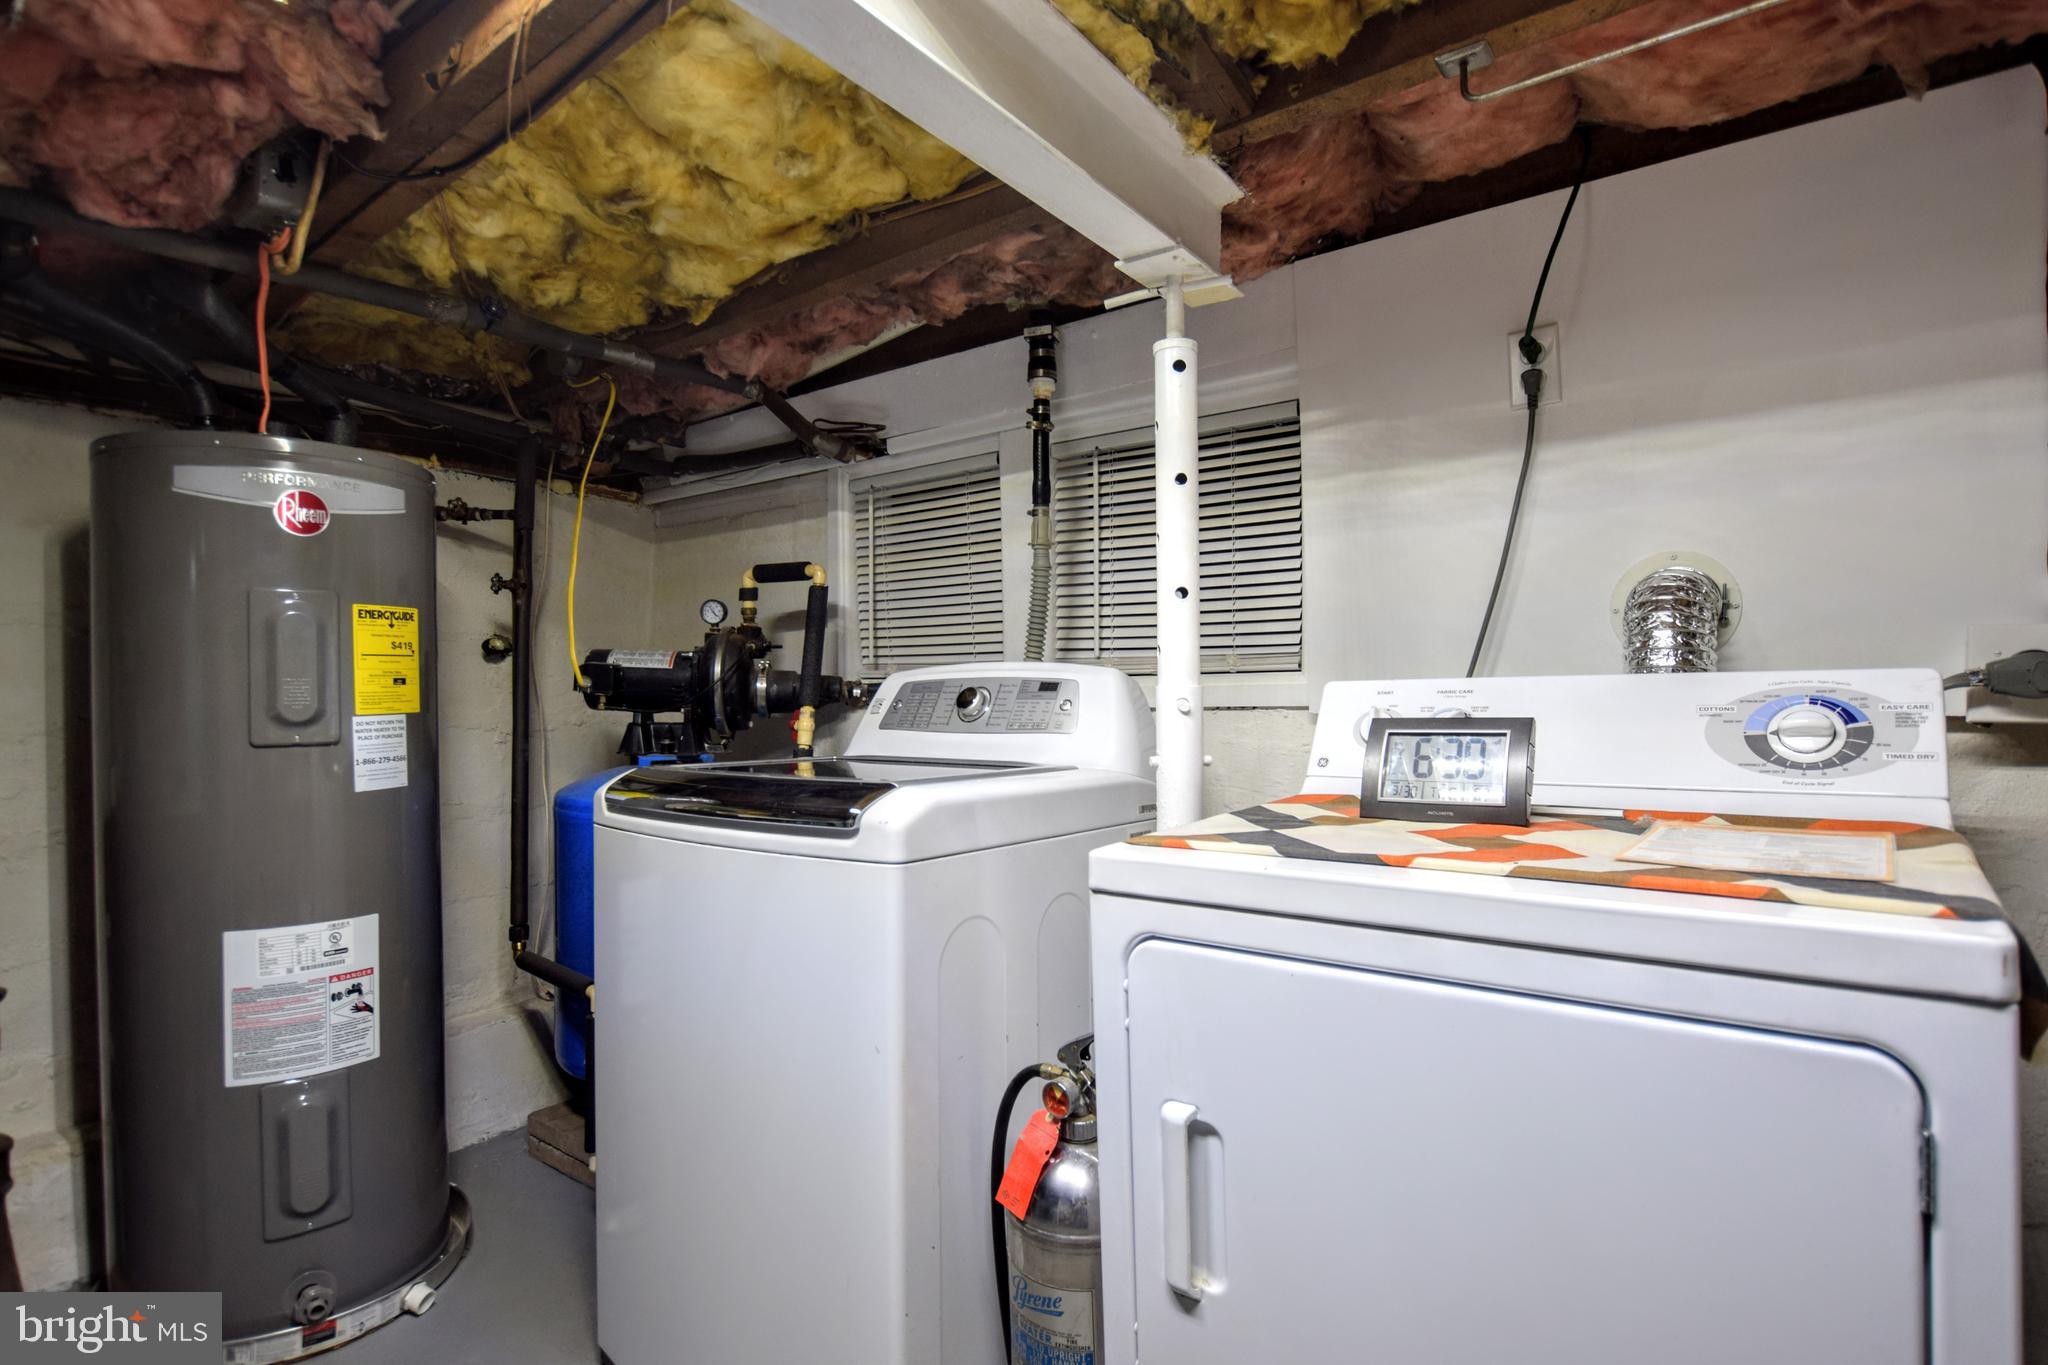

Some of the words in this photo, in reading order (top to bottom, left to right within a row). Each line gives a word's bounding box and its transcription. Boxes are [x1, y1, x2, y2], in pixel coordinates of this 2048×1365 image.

[242, 472, 361, 493] PERFORMANCE
[282, 490, 327, 528] Rheem
[358, 609, 415, 622] ENERGYGUIDE
[391, 641, 413, 650] $419
[340, 969, 371, 980] DANGER
[1012, 1276, 1063, 1310] Pyrene
